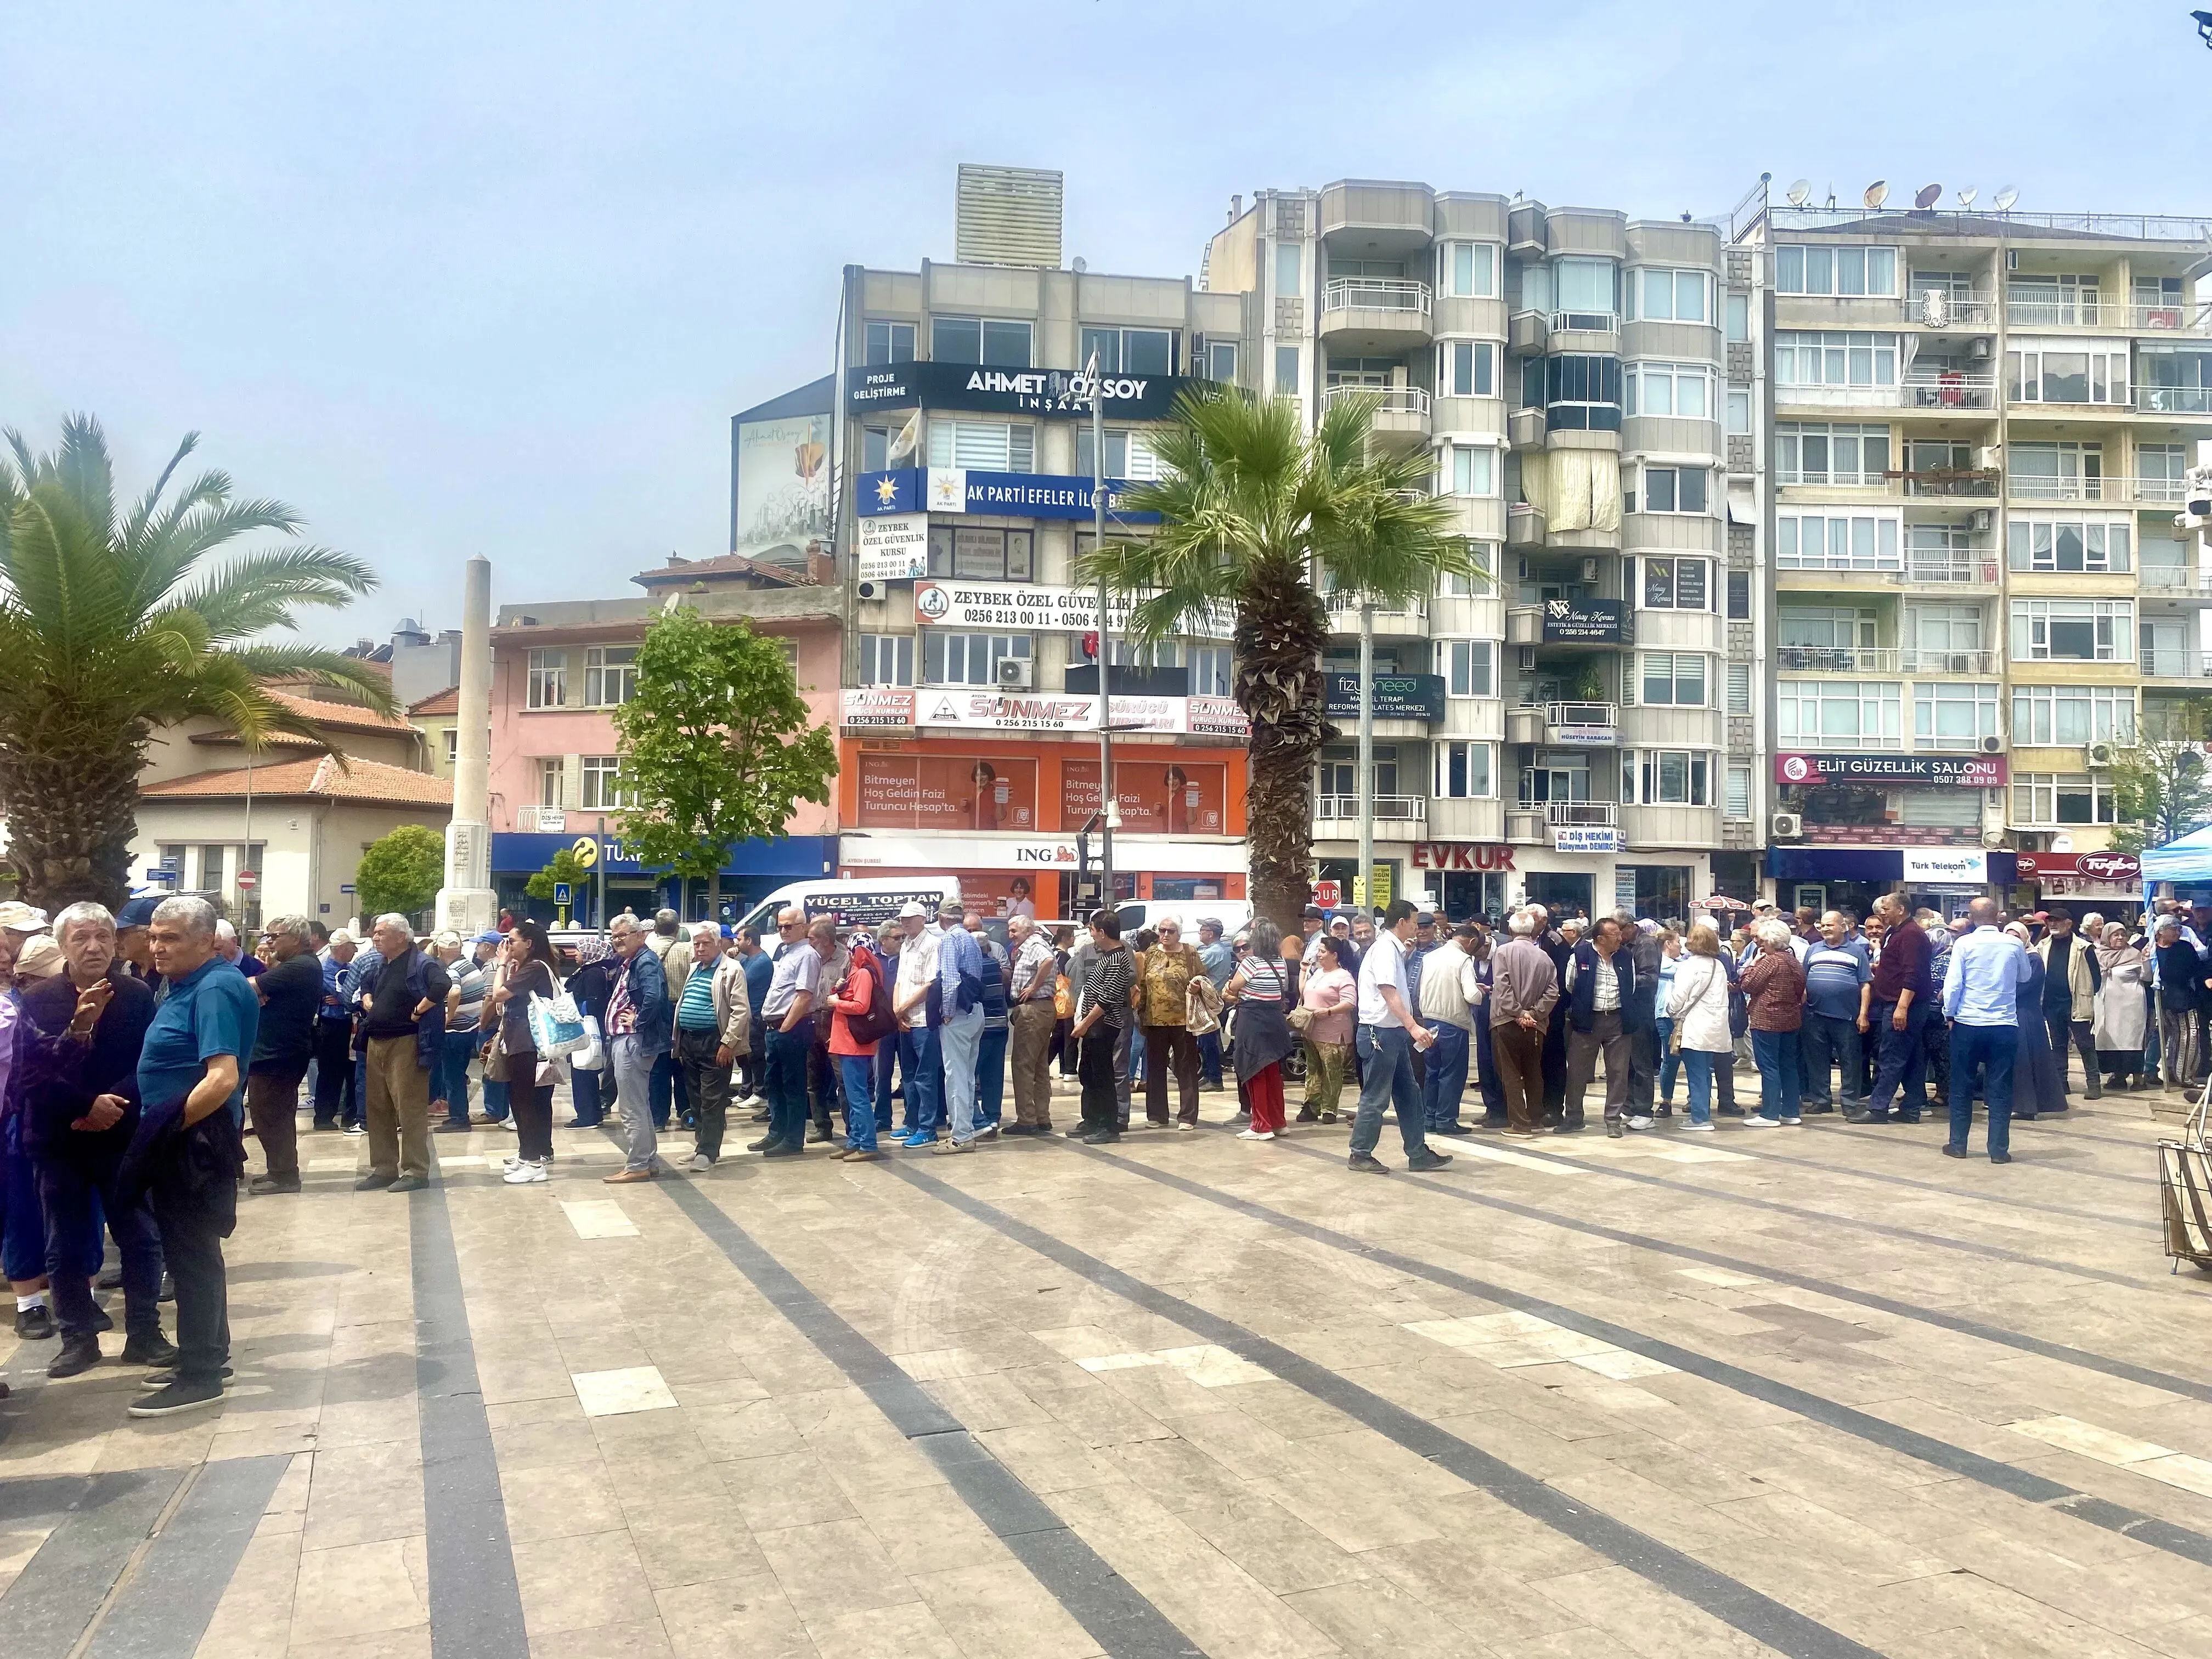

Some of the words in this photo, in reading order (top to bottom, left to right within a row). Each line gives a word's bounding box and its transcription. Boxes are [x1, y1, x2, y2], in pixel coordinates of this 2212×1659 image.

[867, 373, 895, 384] PROJE
[966, 371, 1047, 394] AHMET
[1069, 371, 1148, 399] ÖZSOY
[854, 386, 906, 399] GELİŞTİRME
[1019, 394, 1093, 411] İNŞAAT
[967, 485, 984, 501] AK
[989, 485, 1025, 503] PARTİ
[1029, 489, 1074, 506] EFELER
[878, 523, 909, 532] ZEYBEK
[864, 536, 882, 545] ÖZEL
[885, 532, 924, 544] GÜVENLİK
[881, 548, 906, 556] KURSU
[955, 591, 1012, 606] ZEYBEK
[1017, 590, 1053, 607] ÖZEL
[1058, 592, 1130, 610] GÜVELİK
[964, 609, 992, 623] 0256
[996, 610, 1016, 624] 213
[1020, 611, 1034, 624] 00
[1038, 612, 1050, 625] 11
[1062, 613, 1089, 626] 0506
[1093, 614, 1113, 627] 44
[1565, 611, 1588, 622] Nuray
[1591, 611, 1615, 622] Kovacı
[1338, 676, 1417, 695] fizyneed
[1099, 717, 1175, 729] URSLARI
[1817, 758, 1846, 772] ELİT
[1850, 758, 1927, 773] GÜZELLİK
[1932, 761, 1996, 774] SALONU
[864, 775, 915, 787] Bitmeyen
[1933, 775, 1954, 783] 0507
[1956, 776, 1971, 784] 388
[1066, 780, 1112, 792] Bitmey
[864, 788, 884, 799] Hoş
[887, 788, 919, 798] Geldin
[923, 789, 945, 799] Faizi
[1066, 793, 1084, 804] Hoş
[1119, 794, 1140, 803] Faizi
[864, 801, 906, 811] Turuncu
[910, 802, 958, 814] Hesap'ta.
[1120, 807, 1152, 817] sap'ta.
[1570, 830, 1583, 842] DİŞ
[1585, 830, 1613, 840] HEKİMİ
[1558, 842, 1588, 851] Süleyman
[1589, 841, 1616, 850] DEMİRCİ
[1017, 848, 1052, 862] ING
[1412, 843, 1517, 871] EVKUR
[1931, 862, 1966, 870] Telekom
[805, 896, 862, 906] YÜCEL
[868, 894, 940, 905] TOPTAN
[1314, 889, 1339, 901] DUR
